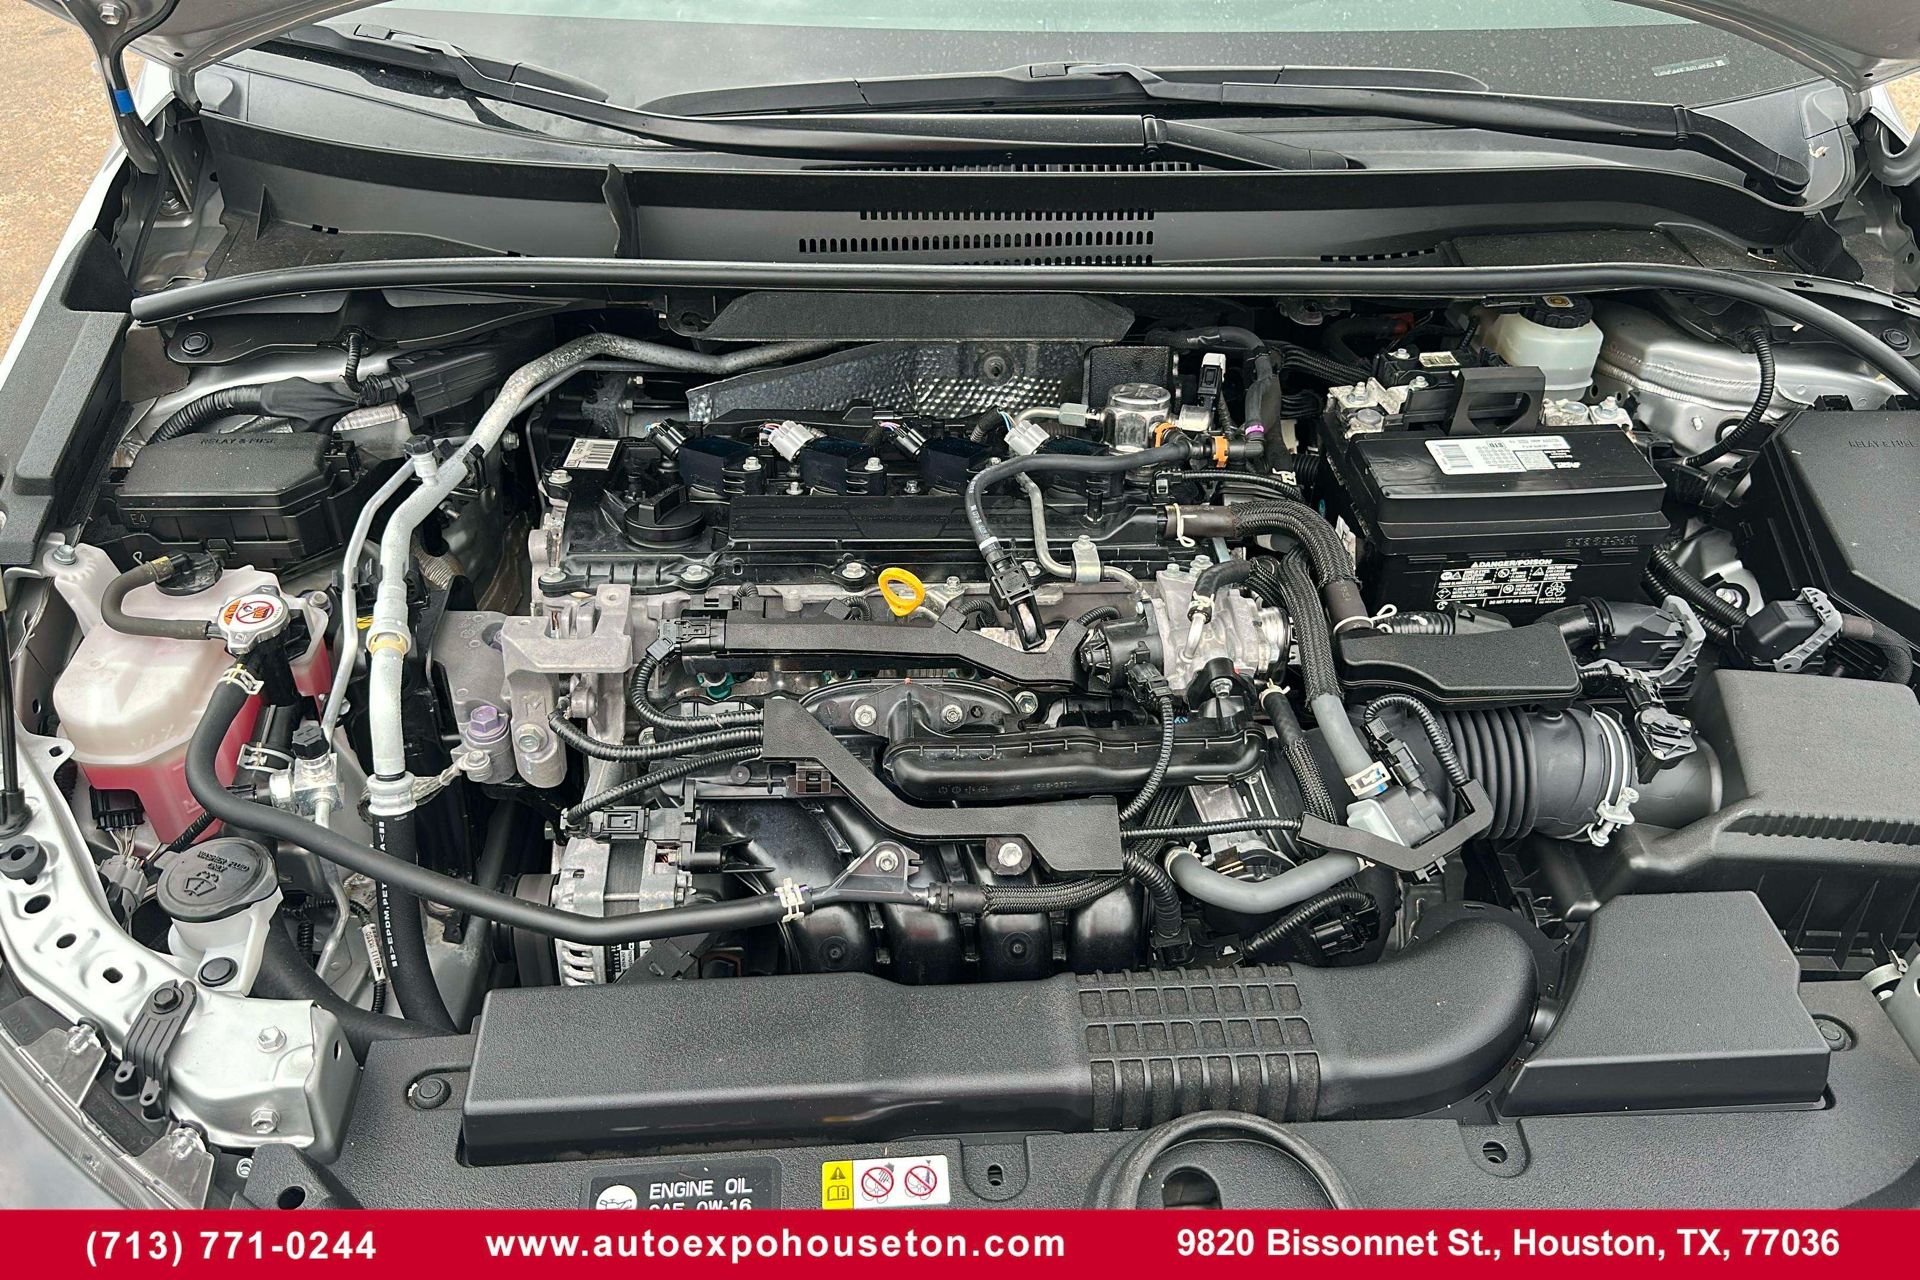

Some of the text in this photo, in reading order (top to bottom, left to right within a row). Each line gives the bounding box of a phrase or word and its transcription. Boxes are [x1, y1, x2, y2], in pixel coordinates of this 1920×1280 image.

[1477, 558, 1553, 569] DANGER/POISON
[649, 1178, 753, 1199] ENGINE OIL
